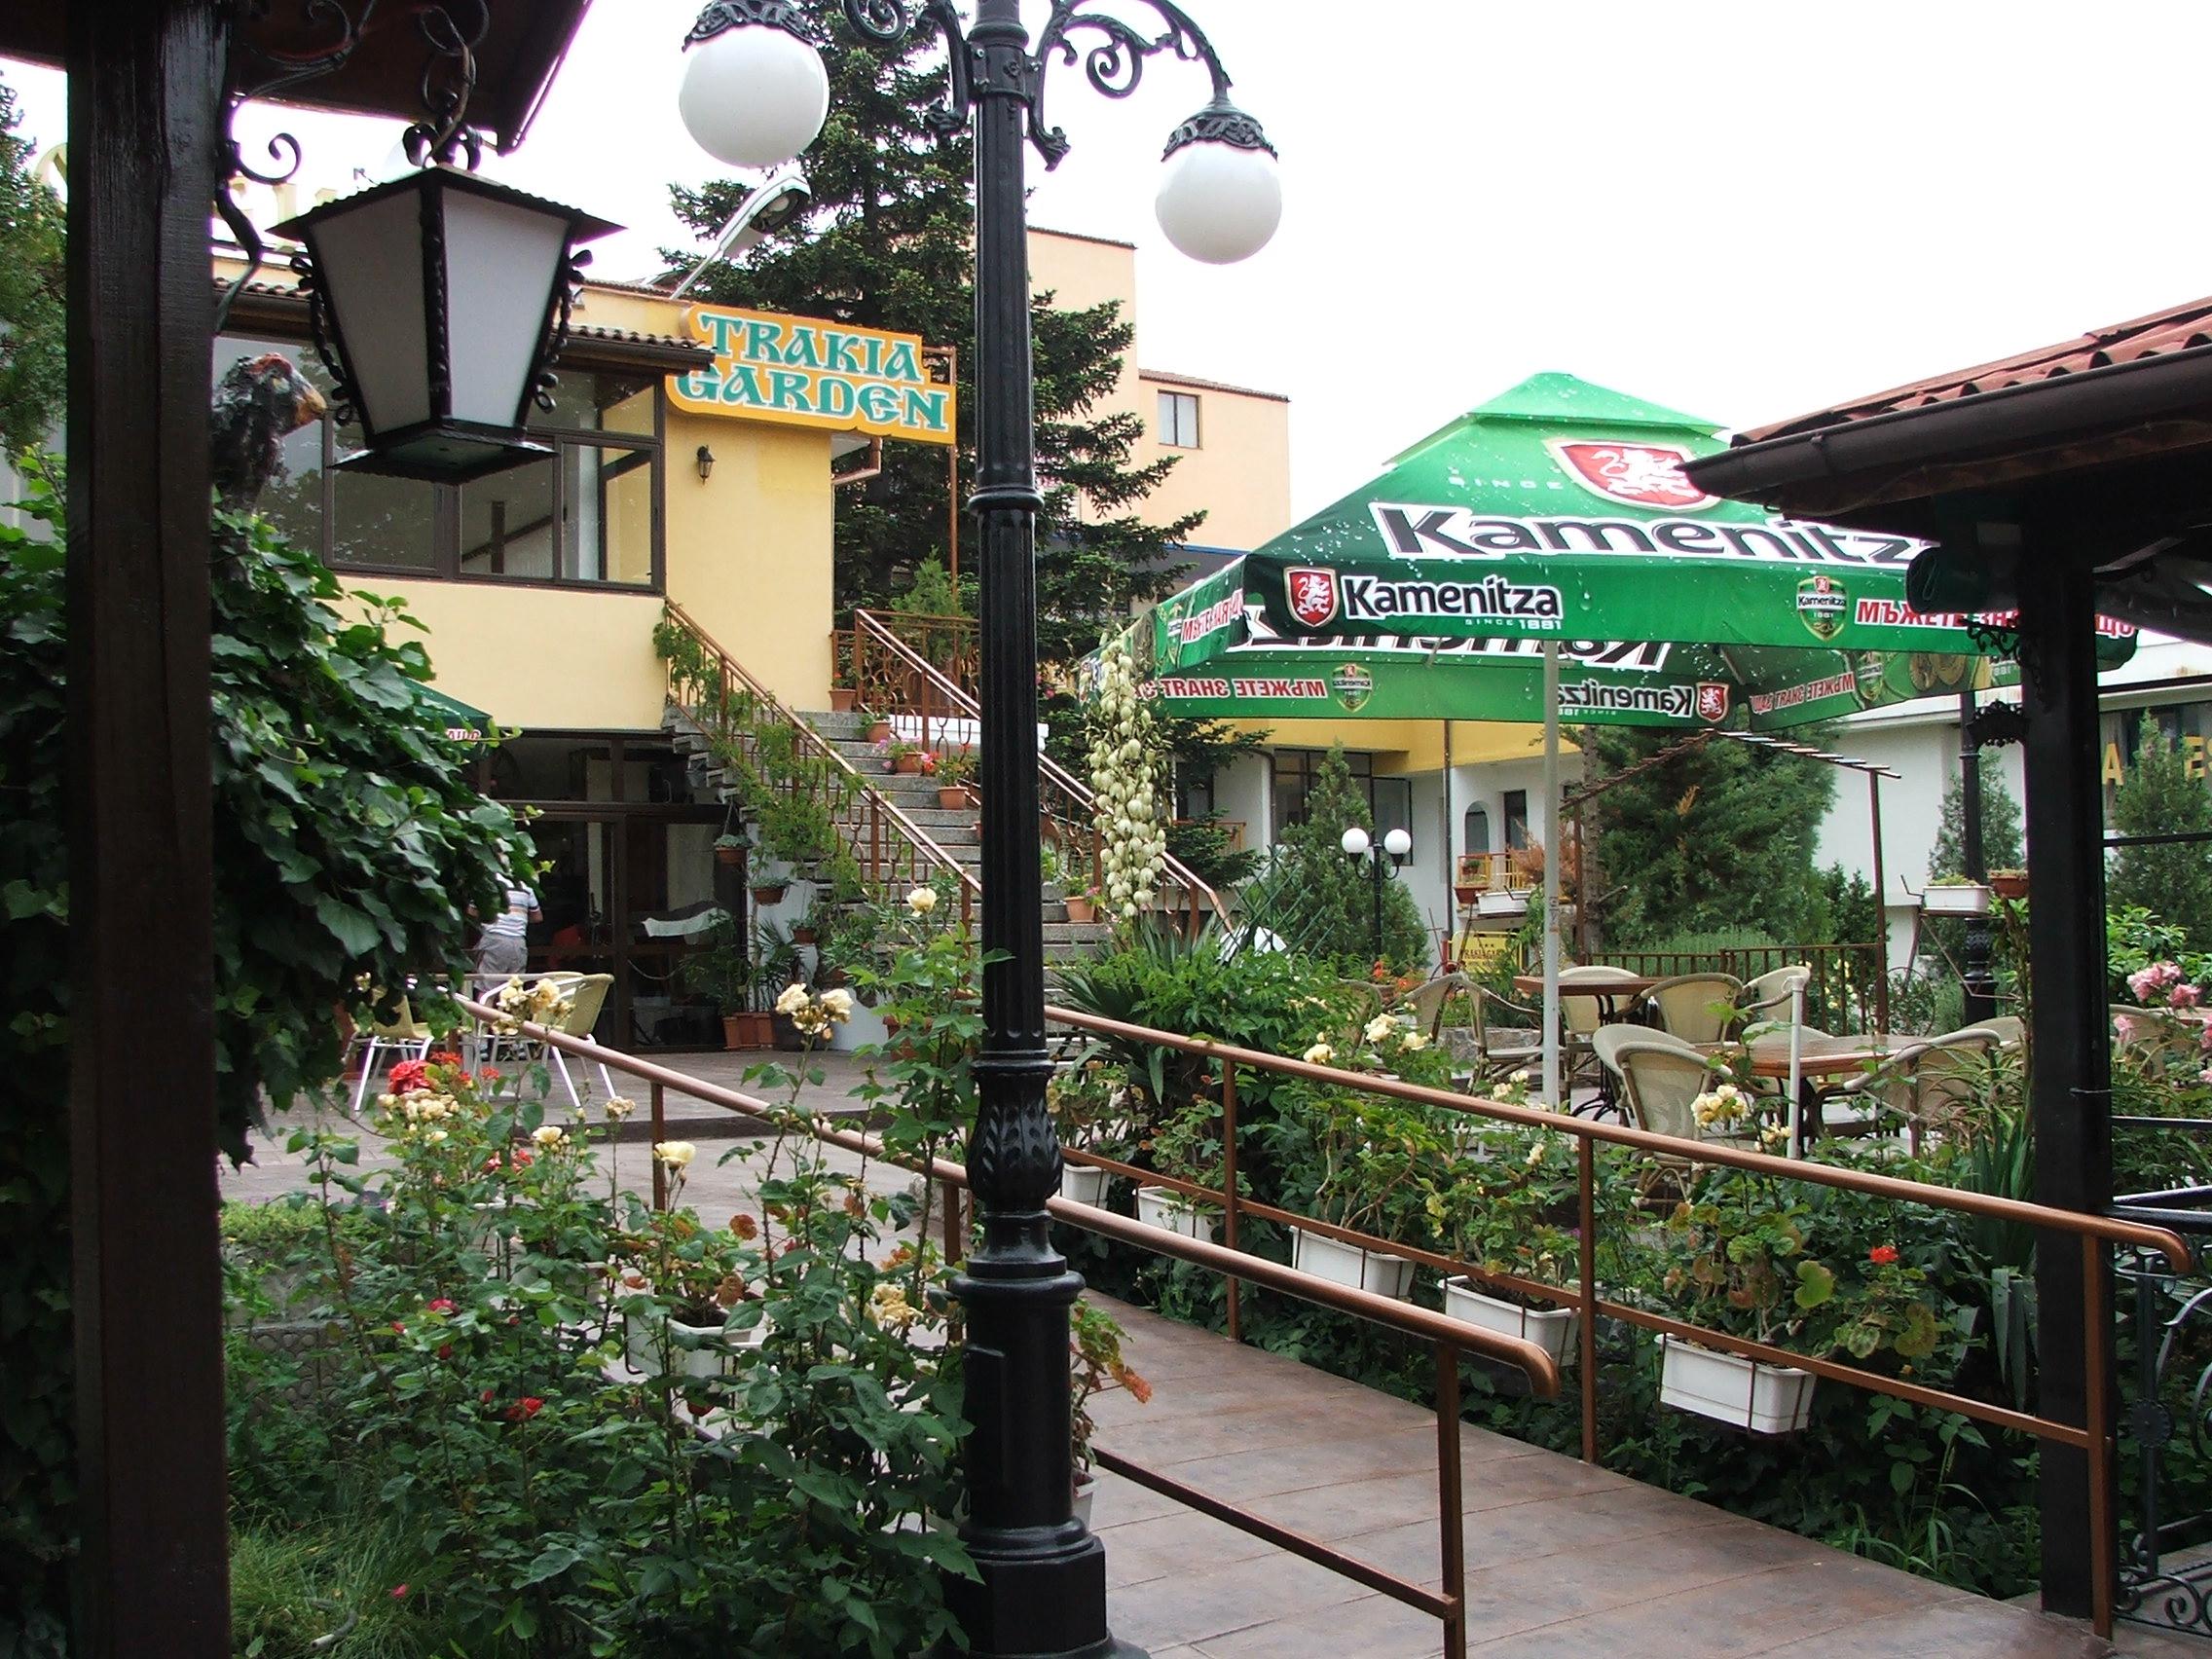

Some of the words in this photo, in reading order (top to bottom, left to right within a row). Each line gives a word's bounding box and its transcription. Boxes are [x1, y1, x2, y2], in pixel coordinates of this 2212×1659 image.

[698, 313, 921, 384] TRAKIA
[676, 362, 948, 431] GARDEN
[1370, 505, 1940, 563] Kamenitz
[1343, 575, 1562, 618] Kamenitza
[1520, 618, 1562, 630] 1881
